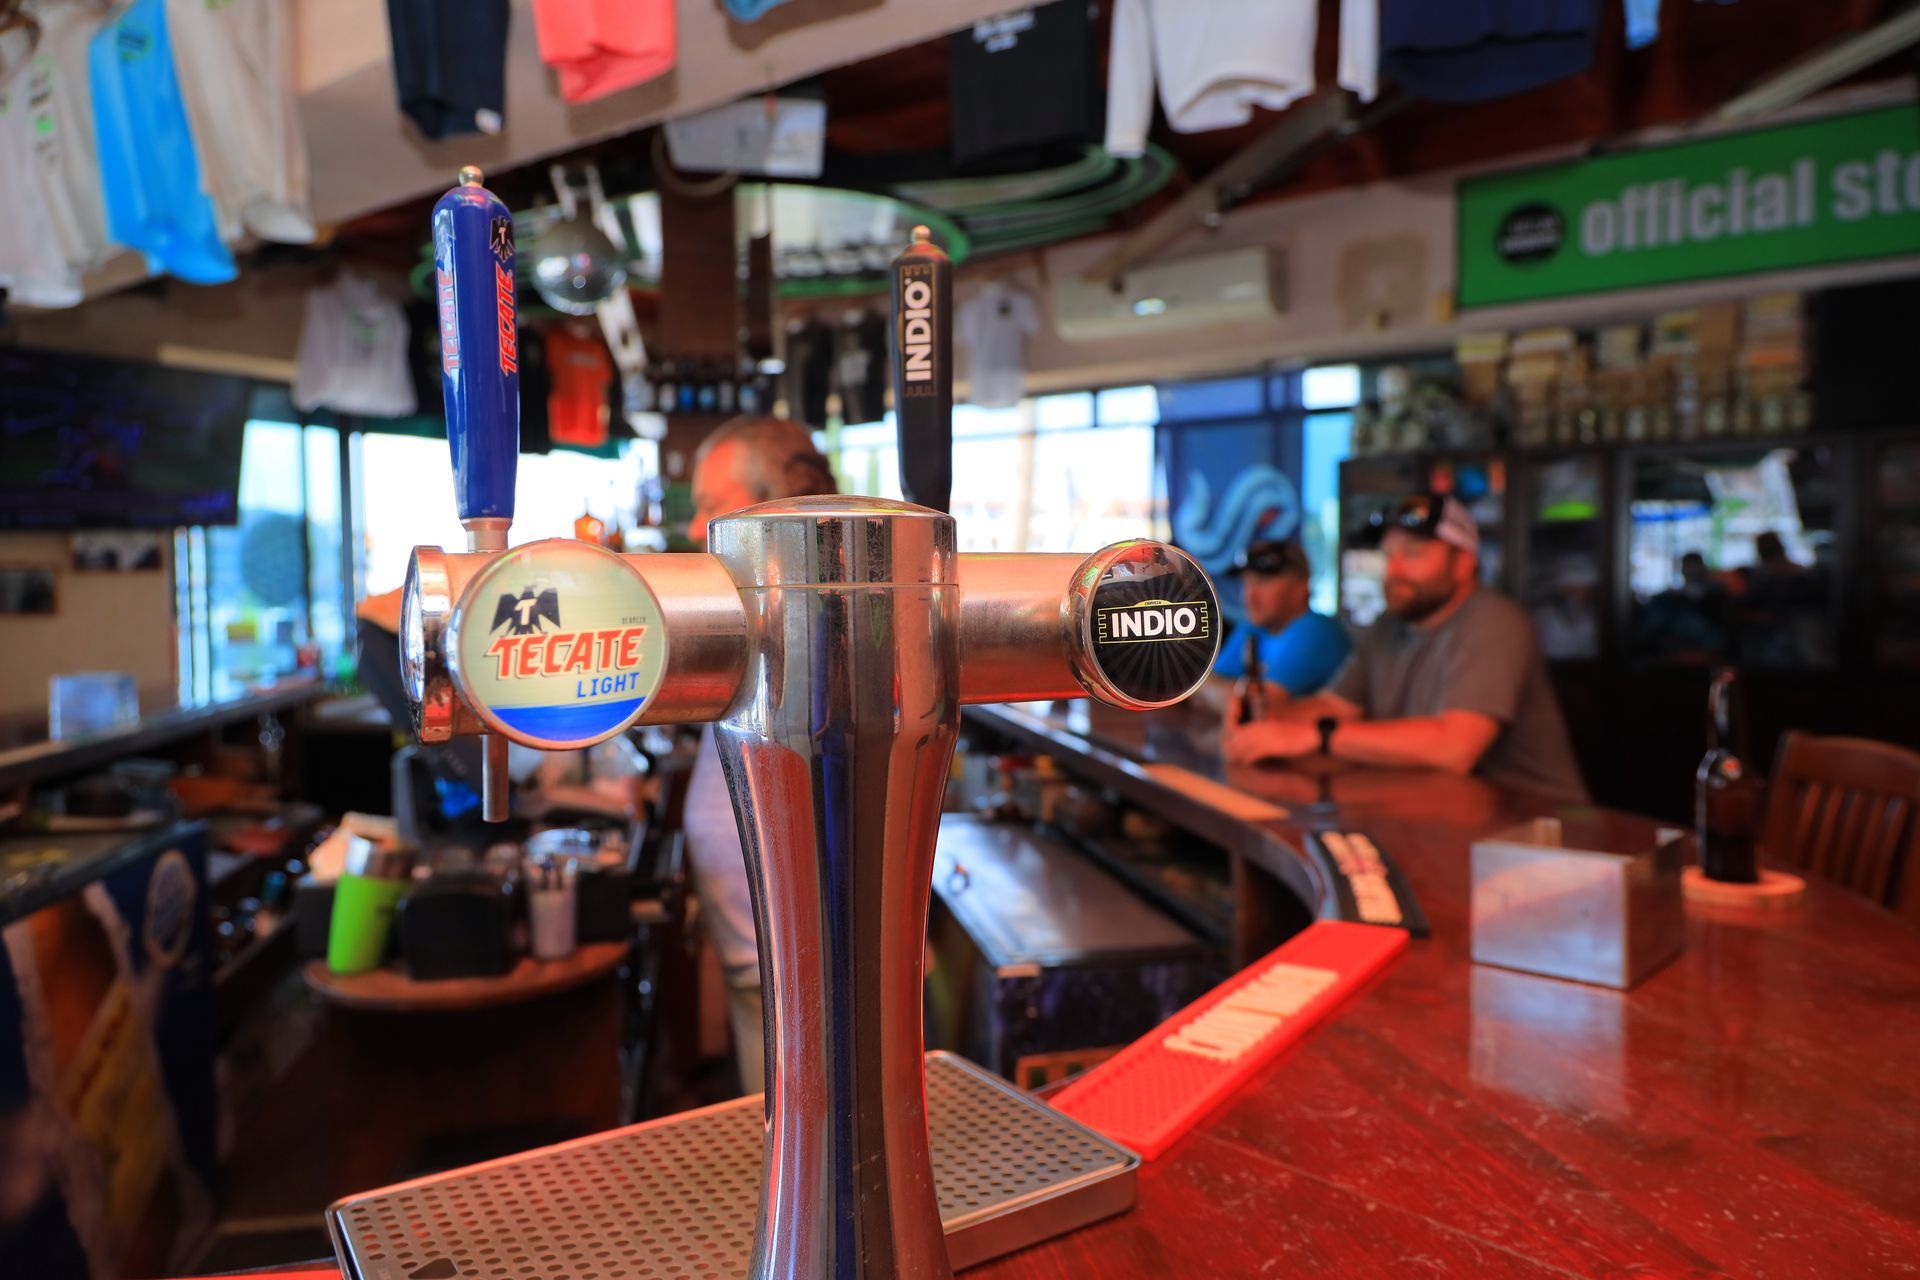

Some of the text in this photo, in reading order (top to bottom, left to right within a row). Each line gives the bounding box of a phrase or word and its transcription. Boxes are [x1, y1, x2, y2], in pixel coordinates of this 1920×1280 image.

[1579, 158, 1815, 257] official
[495, 261, 518, 377] TECATE
[904, 280, 932, 382] INDIO
[483, 625, 648, 681] TECATE
[1111, 607, 1196, 638] INDIO
[576, 672, 640, 698] LIGHT
